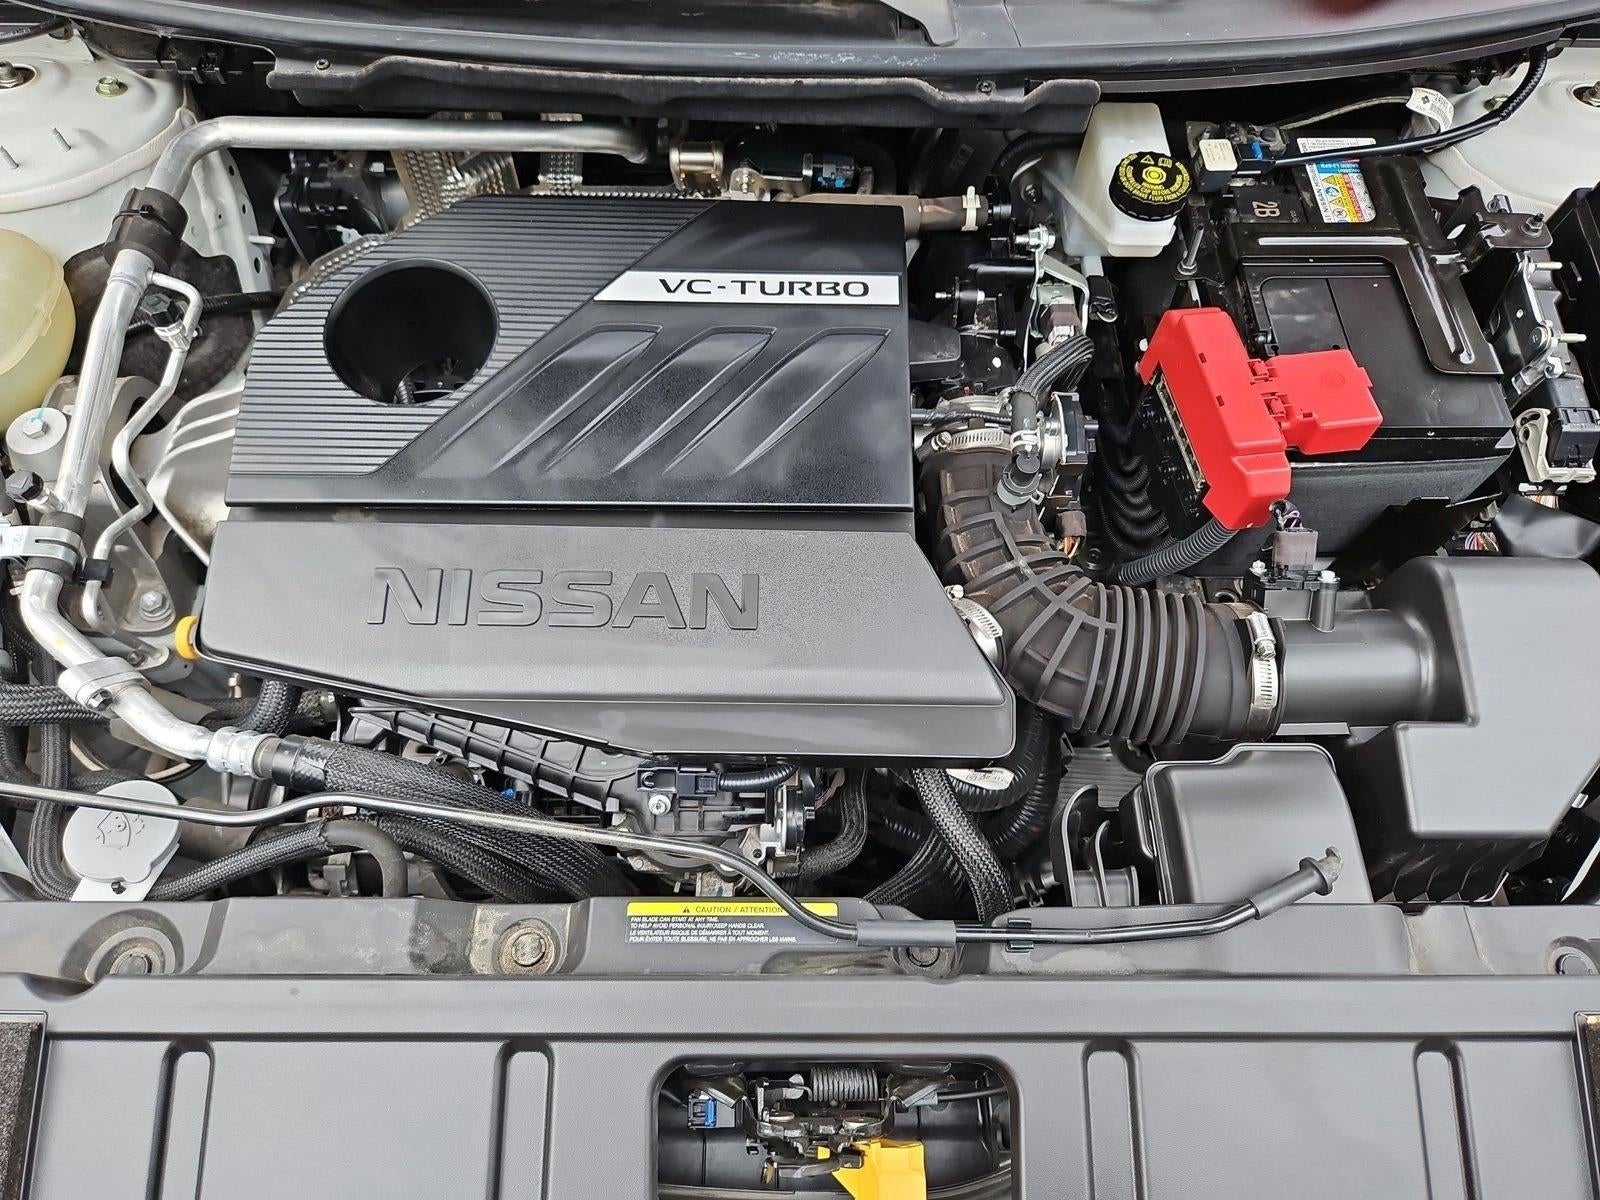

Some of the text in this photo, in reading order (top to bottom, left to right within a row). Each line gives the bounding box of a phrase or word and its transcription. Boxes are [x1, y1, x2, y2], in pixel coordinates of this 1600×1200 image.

[1252, 201, 1280, 217] 2B
[658, 278, 869, 298] VC-TURBO
[366, 567, 760, 631] NISSAN
